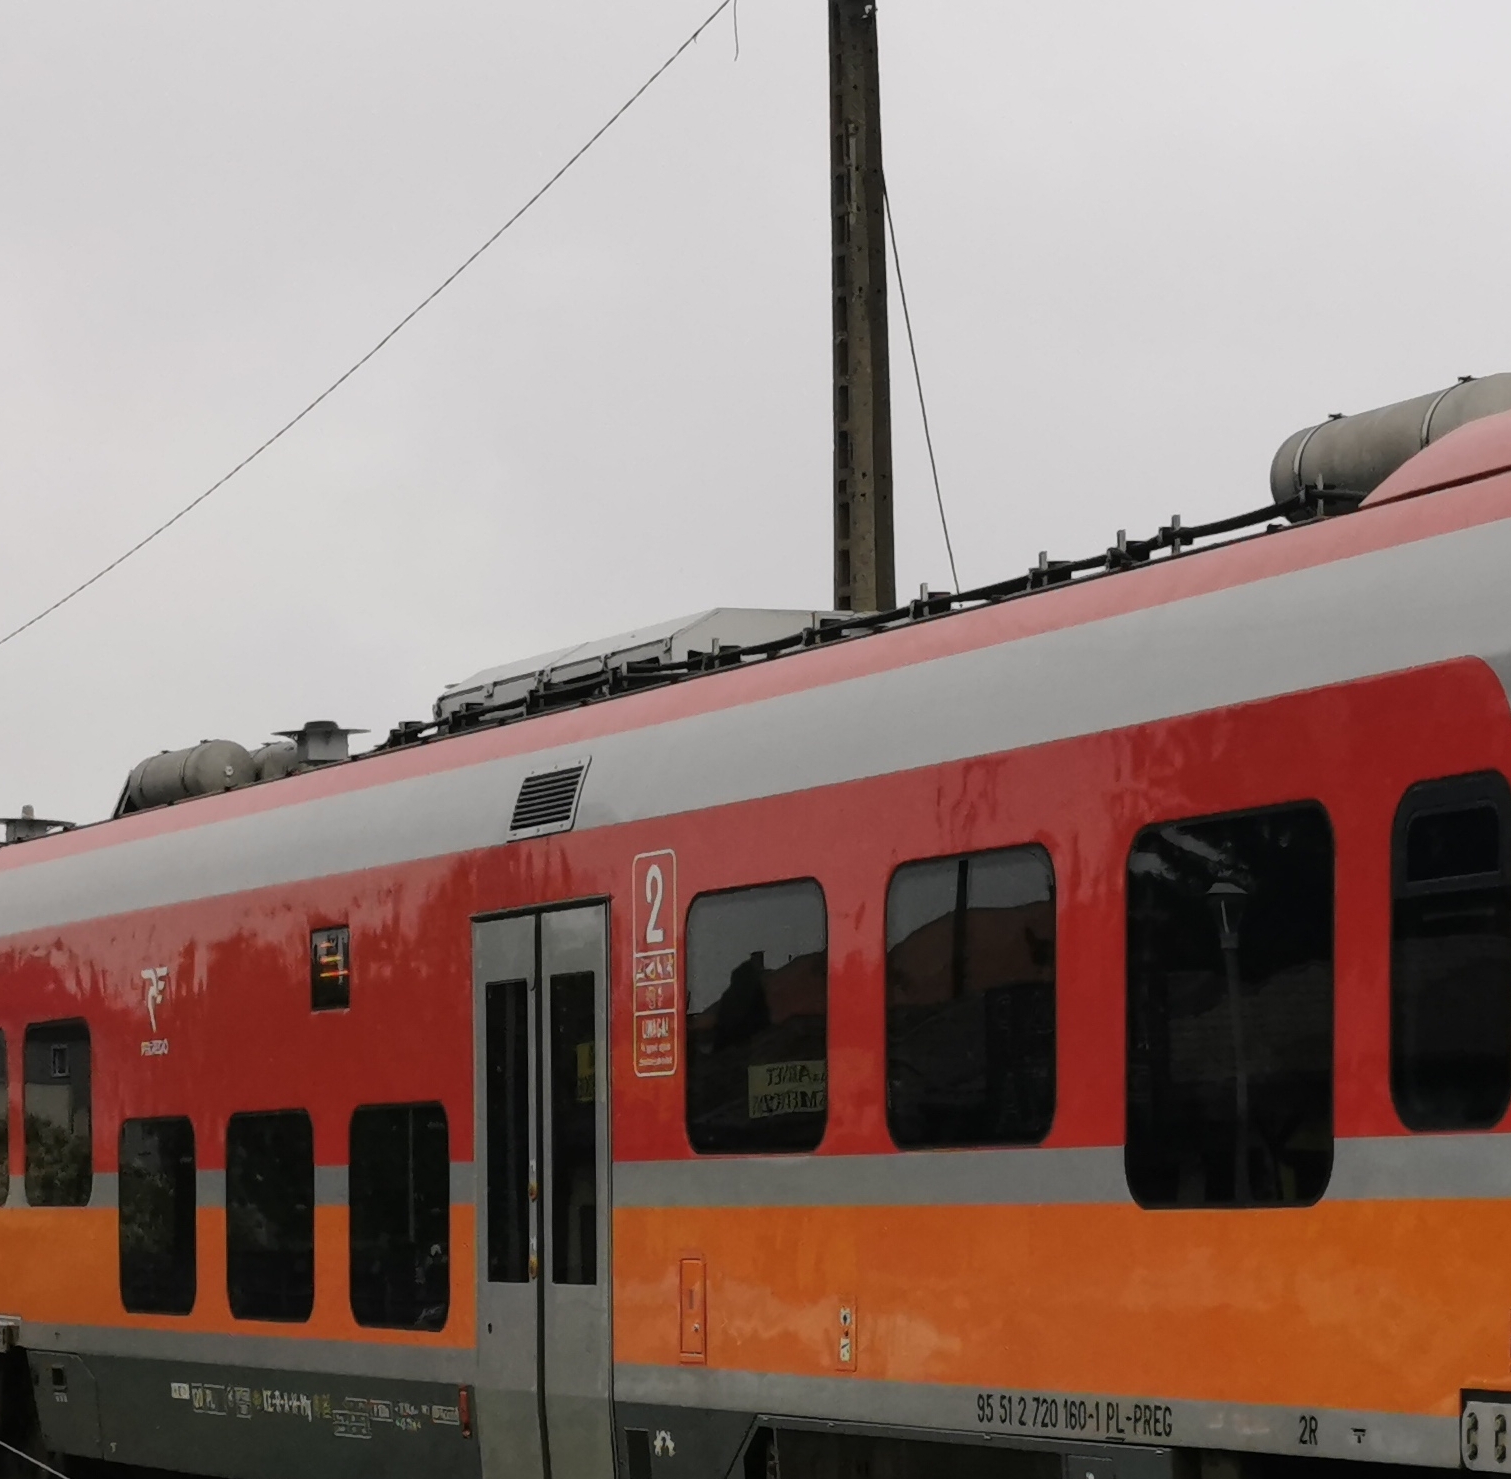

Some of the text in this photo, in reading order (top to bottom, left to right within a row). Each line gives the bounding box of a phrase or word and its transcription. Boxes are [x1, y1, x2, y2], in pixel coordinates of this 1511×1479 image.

[645, 864, 664, 943] 2
[977, 1393, 993, 1423] 95
[999, 1394, 1012, 1425] 51
[1018, 1396, 1027, 1427] 2
[1032, 1396, 1058, 1428] 720
[1063, 1398, 1100, 1432] 160-1
[1298, 1414, 1318, 1445] 2R
